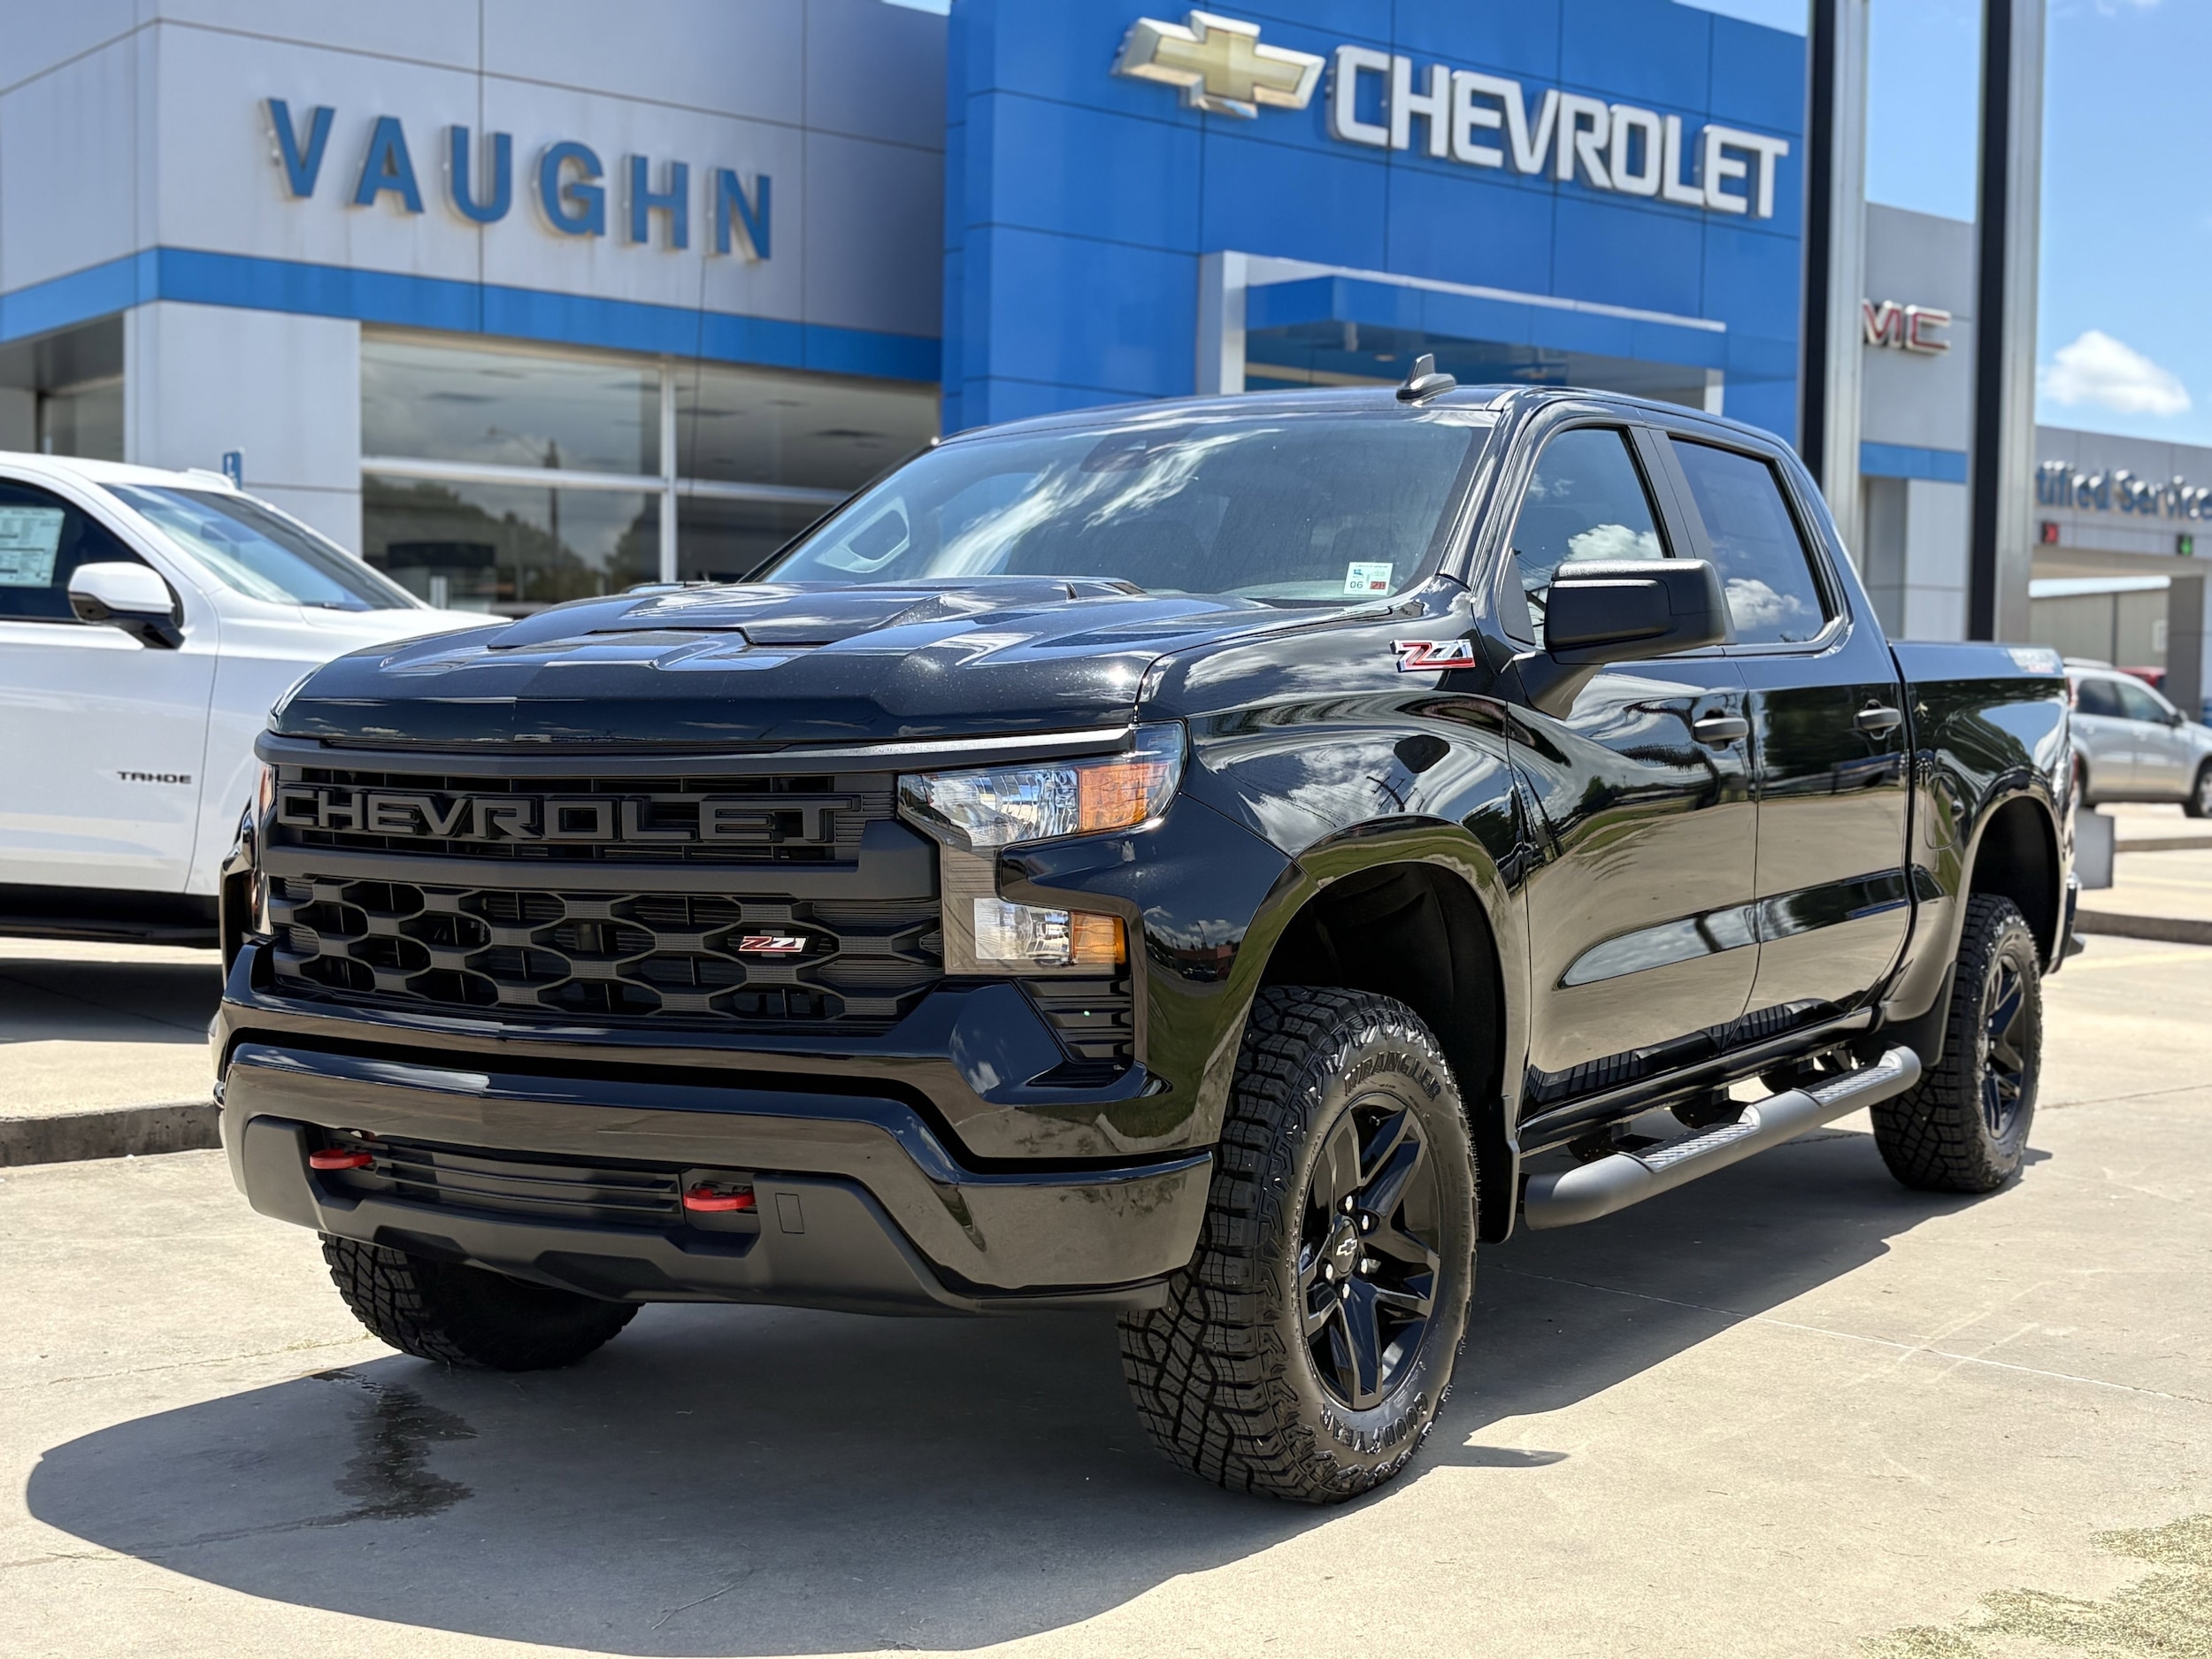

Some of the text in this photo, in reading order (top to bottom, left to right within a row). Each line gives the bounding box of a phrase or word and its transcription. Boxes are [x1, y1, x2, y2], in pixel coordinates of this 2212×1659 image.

[1334, 44, 1789, 219] CHEVROLET
[265, 97, 772, 261] VAUGHN
[1862, 298, 1951, 355] MC
[2036, 460, 2110, 511] tified
[116, 771, 192, 784] TAHOE
[277, 784, 862, 843] CHEVROLET
[1344, 1050, 1442, 1101] WRANGLER
